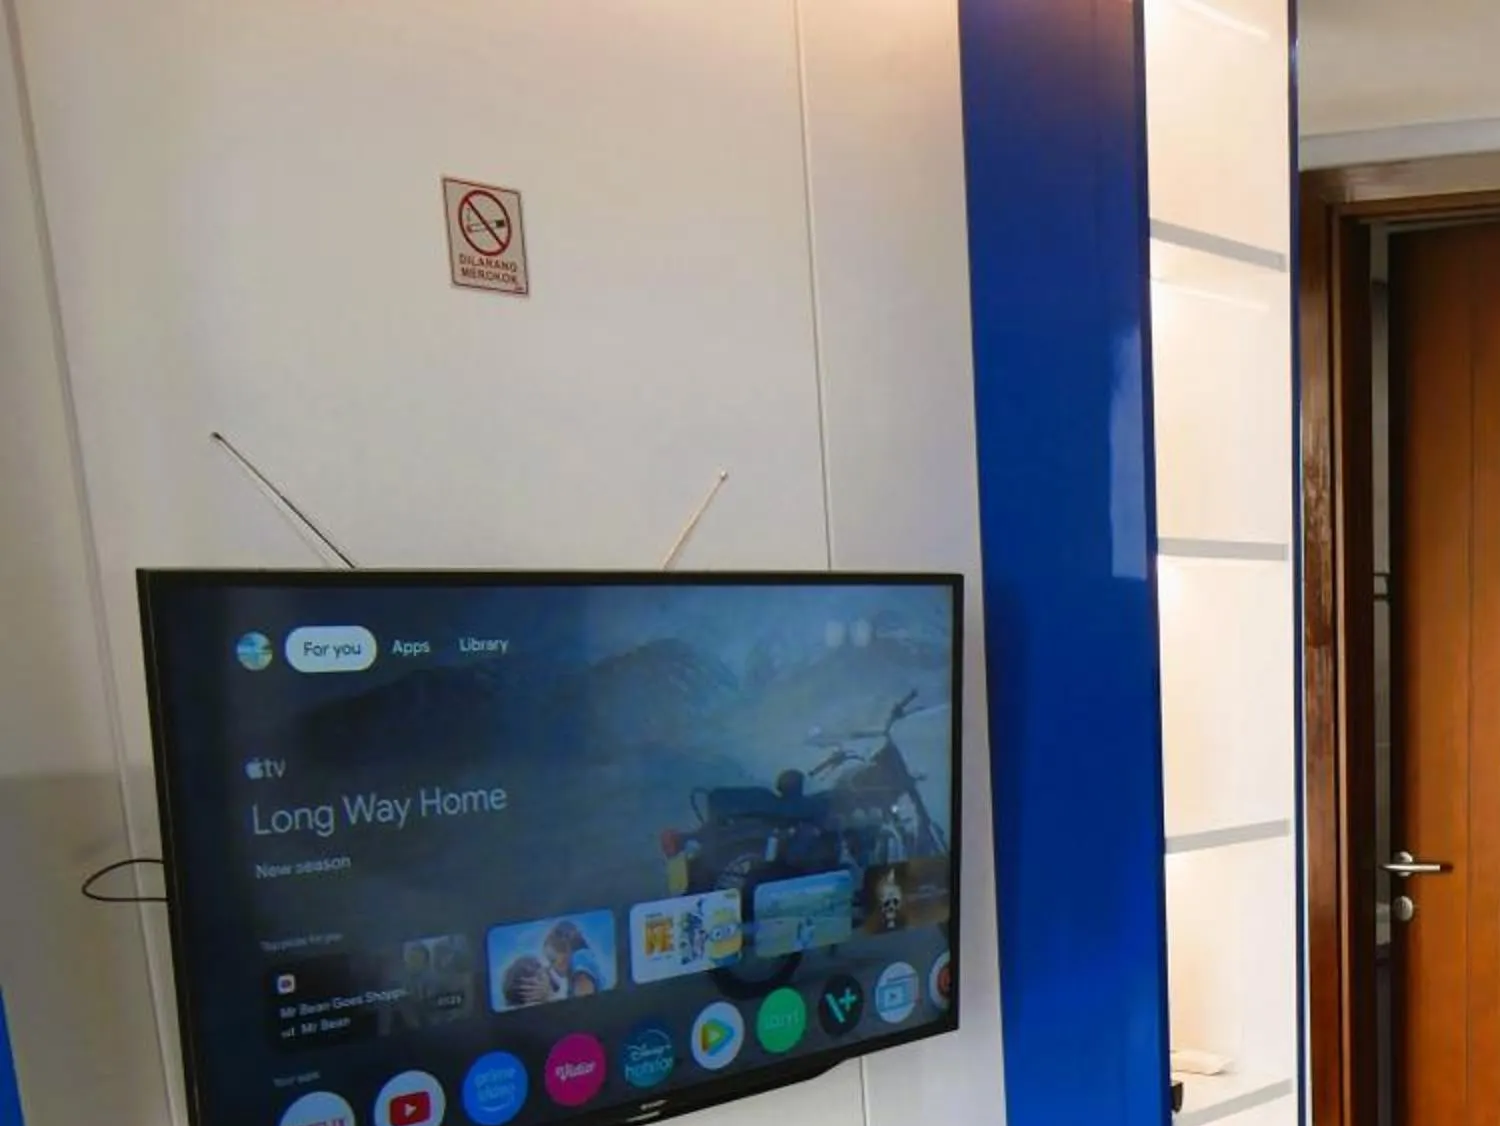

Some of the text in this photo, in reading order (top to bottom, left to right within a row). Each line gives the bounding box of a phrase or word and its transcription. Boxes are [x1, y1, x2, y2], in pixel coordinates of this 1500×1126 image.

[459, 254, 518, 272] DILARANG
[461, 267, 518, 283] MEROKOK
[303, 641, 362, 660] For you
[392, 639, 430, 656] Apps
[459, 636, 509, 655] Library
[264, 760, 286, 778] tv
[252, 787, 507, 838] Long Way Home
[255, 856, 351, 879] New season
[280, 1006, 297, 1019] Mr
[299, 1003, 330, 1016] Bean
[301, 1022, 318, 1035] Mr
[320, 1017, 351, 1031] Bean
